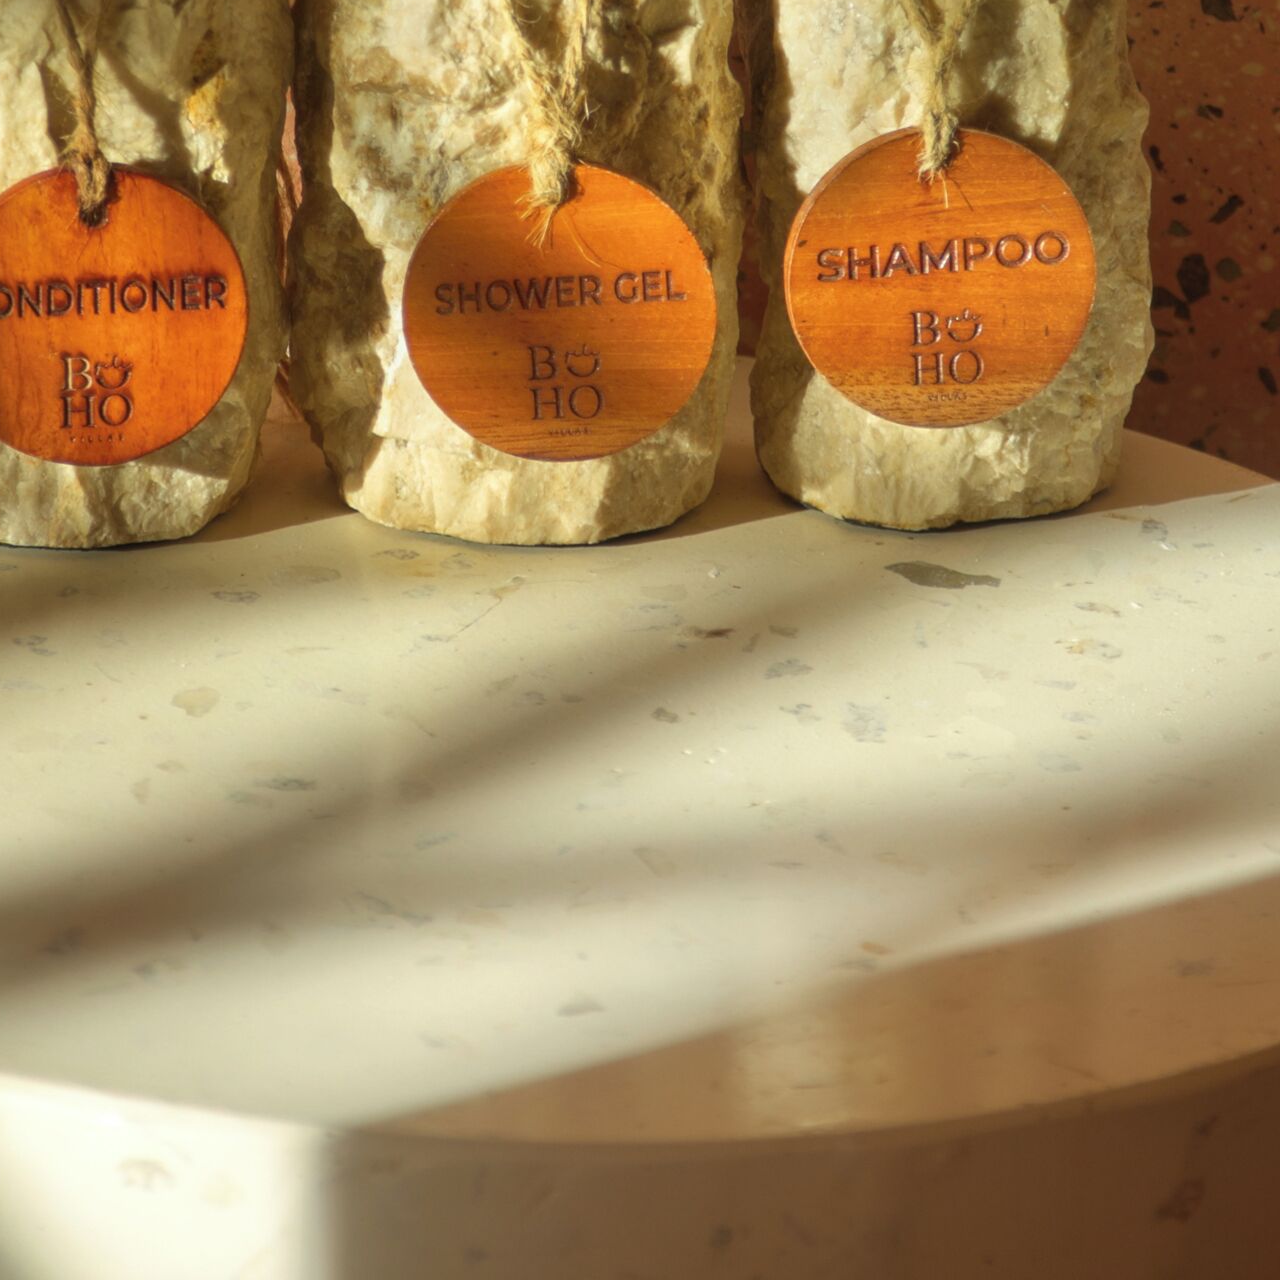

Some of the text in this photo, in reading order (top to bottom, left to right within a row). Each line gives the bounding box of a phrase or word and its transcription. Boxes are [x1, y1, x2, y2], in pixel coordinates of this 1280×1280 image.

[816, 230, 1071, 282] SHAMPOO
[434, 269, 688, 316] SHOWER GEL
[911, 350, 984, 386] HO
[61, 393, 133, 428] HO
[529, 385, 604, 420] HO
